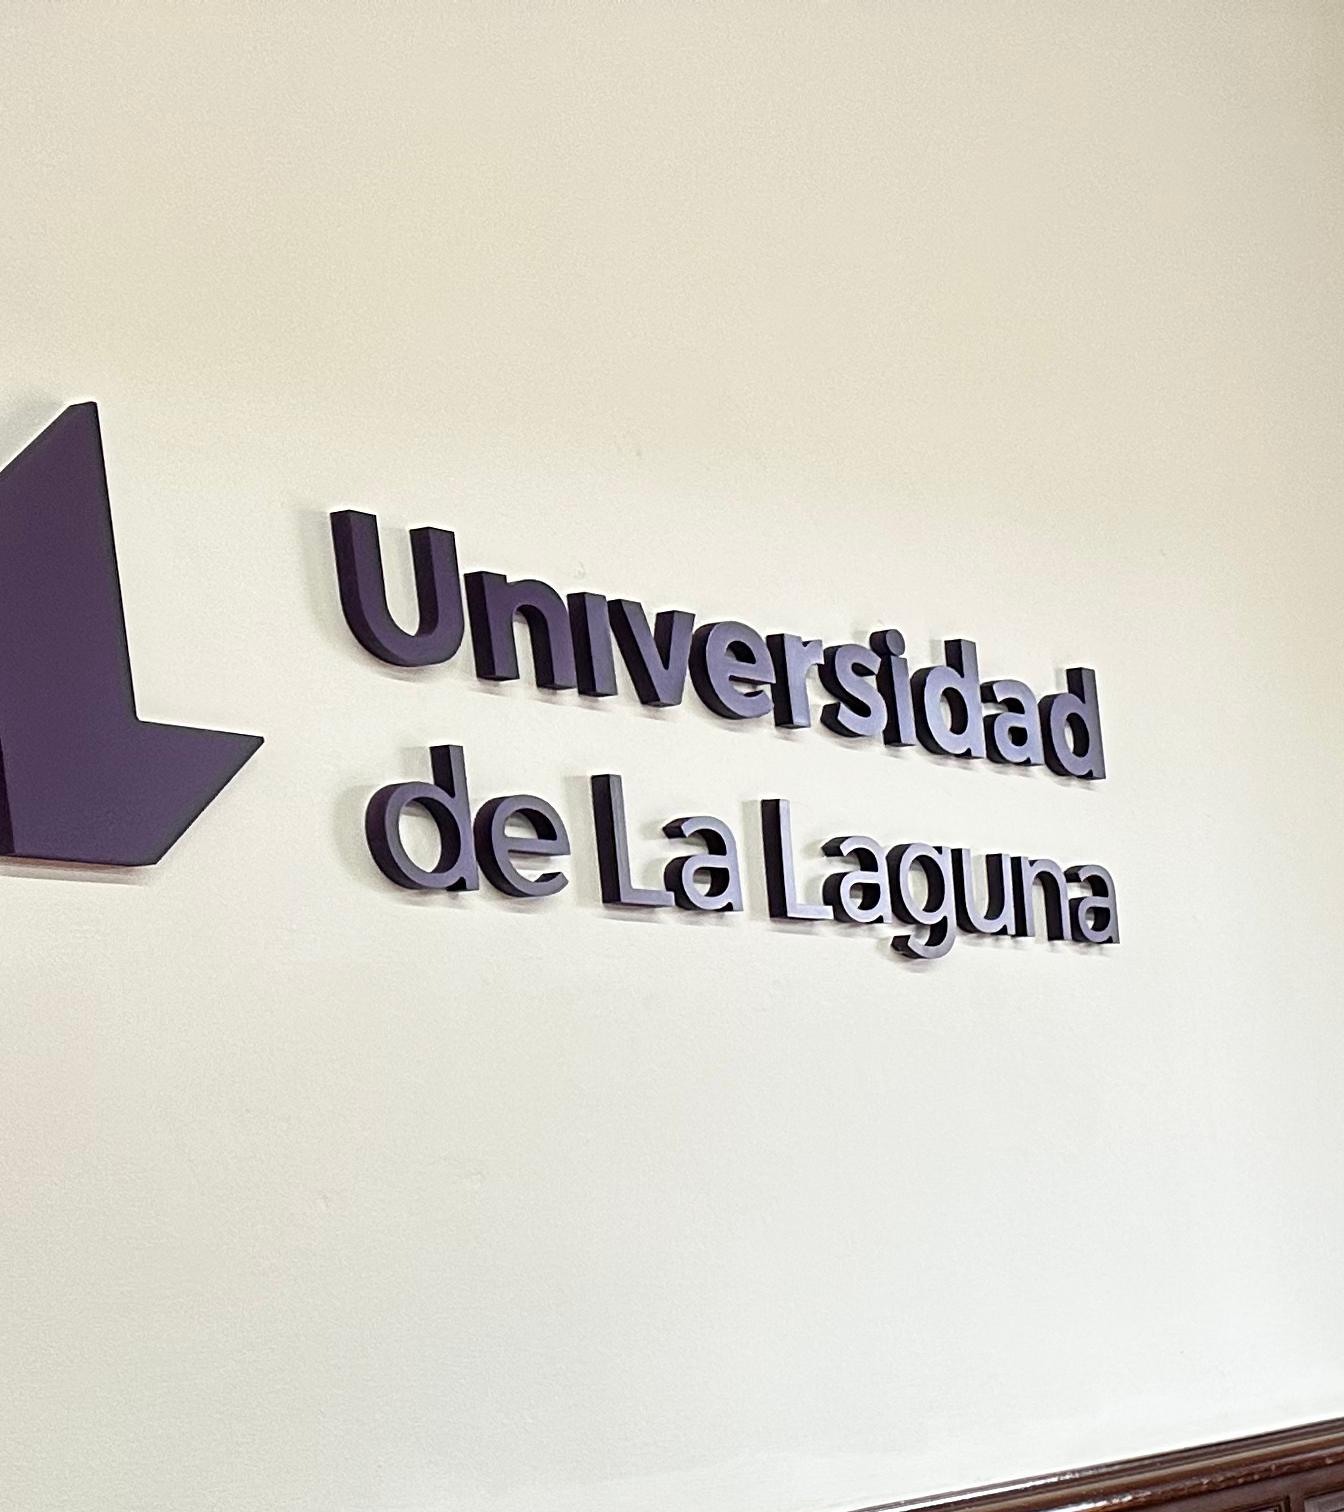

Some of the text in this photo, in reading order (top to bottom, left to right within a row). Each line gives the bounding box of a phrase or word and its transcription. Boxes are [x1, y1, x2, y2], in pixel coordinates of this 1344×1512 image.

[330, 508, 1107, 781] Universidad
[364, 744, 1121, 960] de La Laguna
